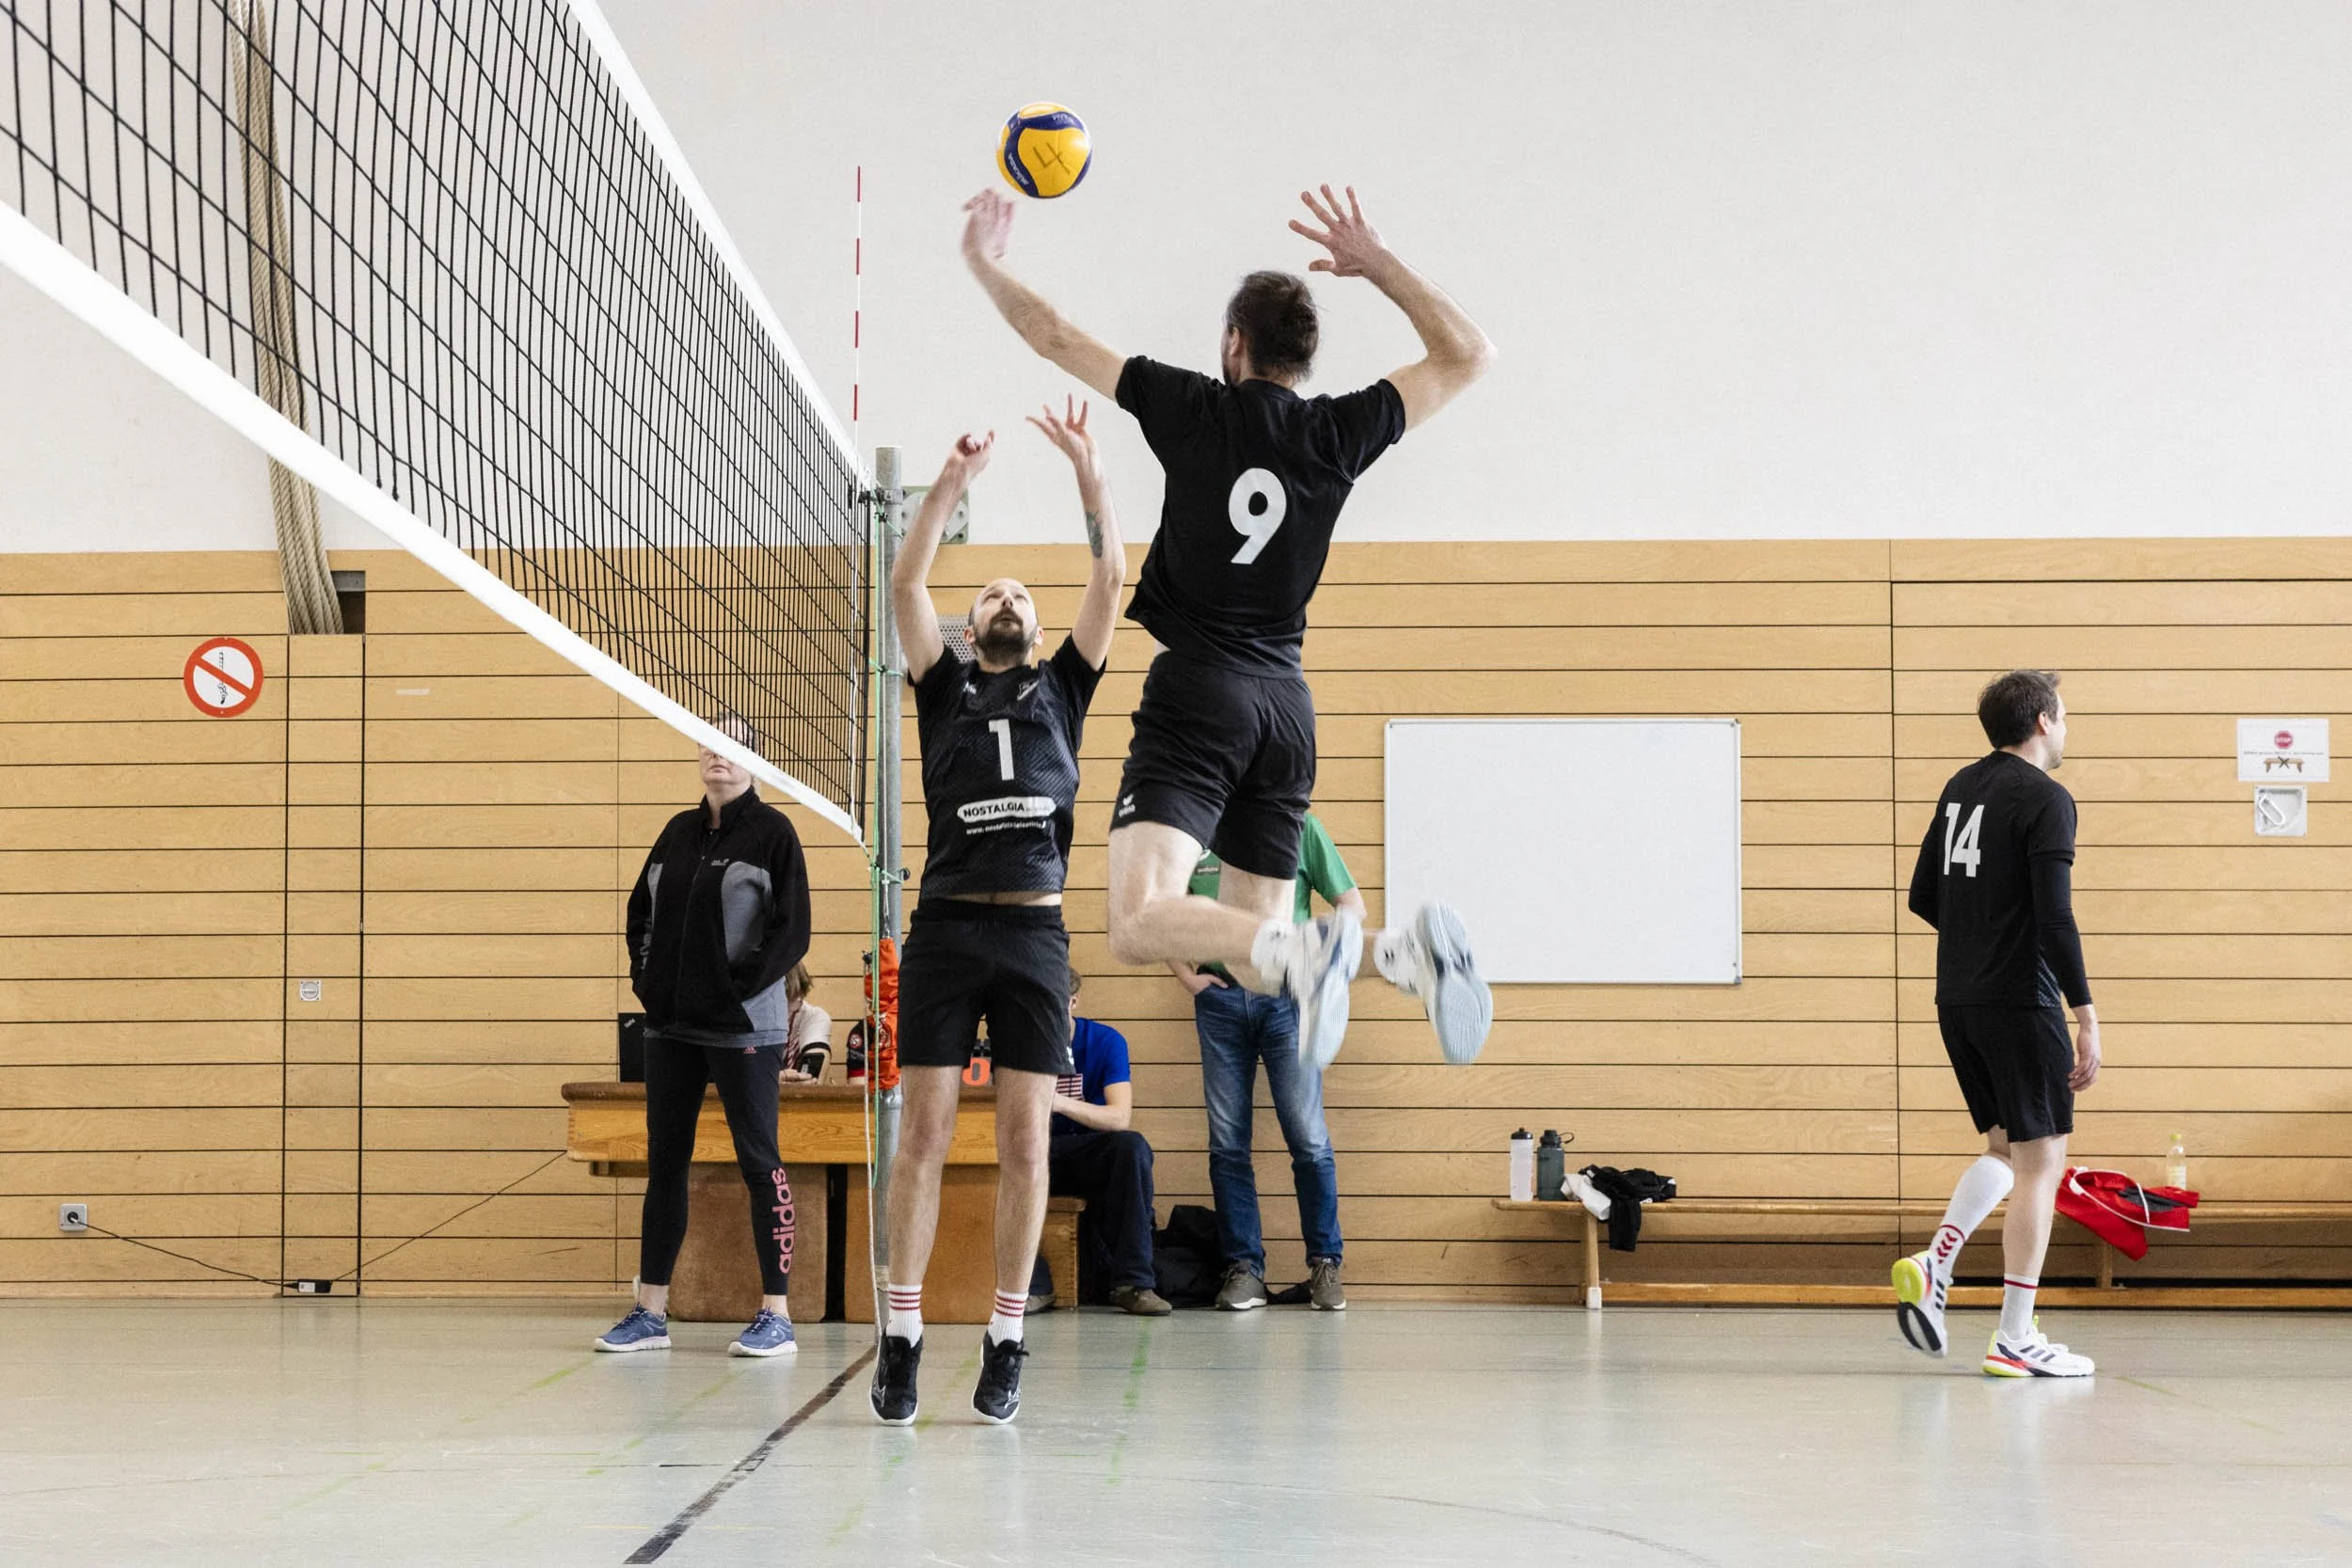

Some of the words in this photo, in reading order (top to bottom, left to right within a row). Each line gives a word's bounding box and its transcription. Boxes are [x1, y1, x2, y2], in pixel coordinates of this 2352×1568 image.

[1229, 467, 1287, 564] 9
[988, 719, 1014, 782] 1
[963, 802, 1025, 817] NOSTALGIA
[1944, 802, 1984, 878] 14
[771, 1166, 795, 1274] adidas
